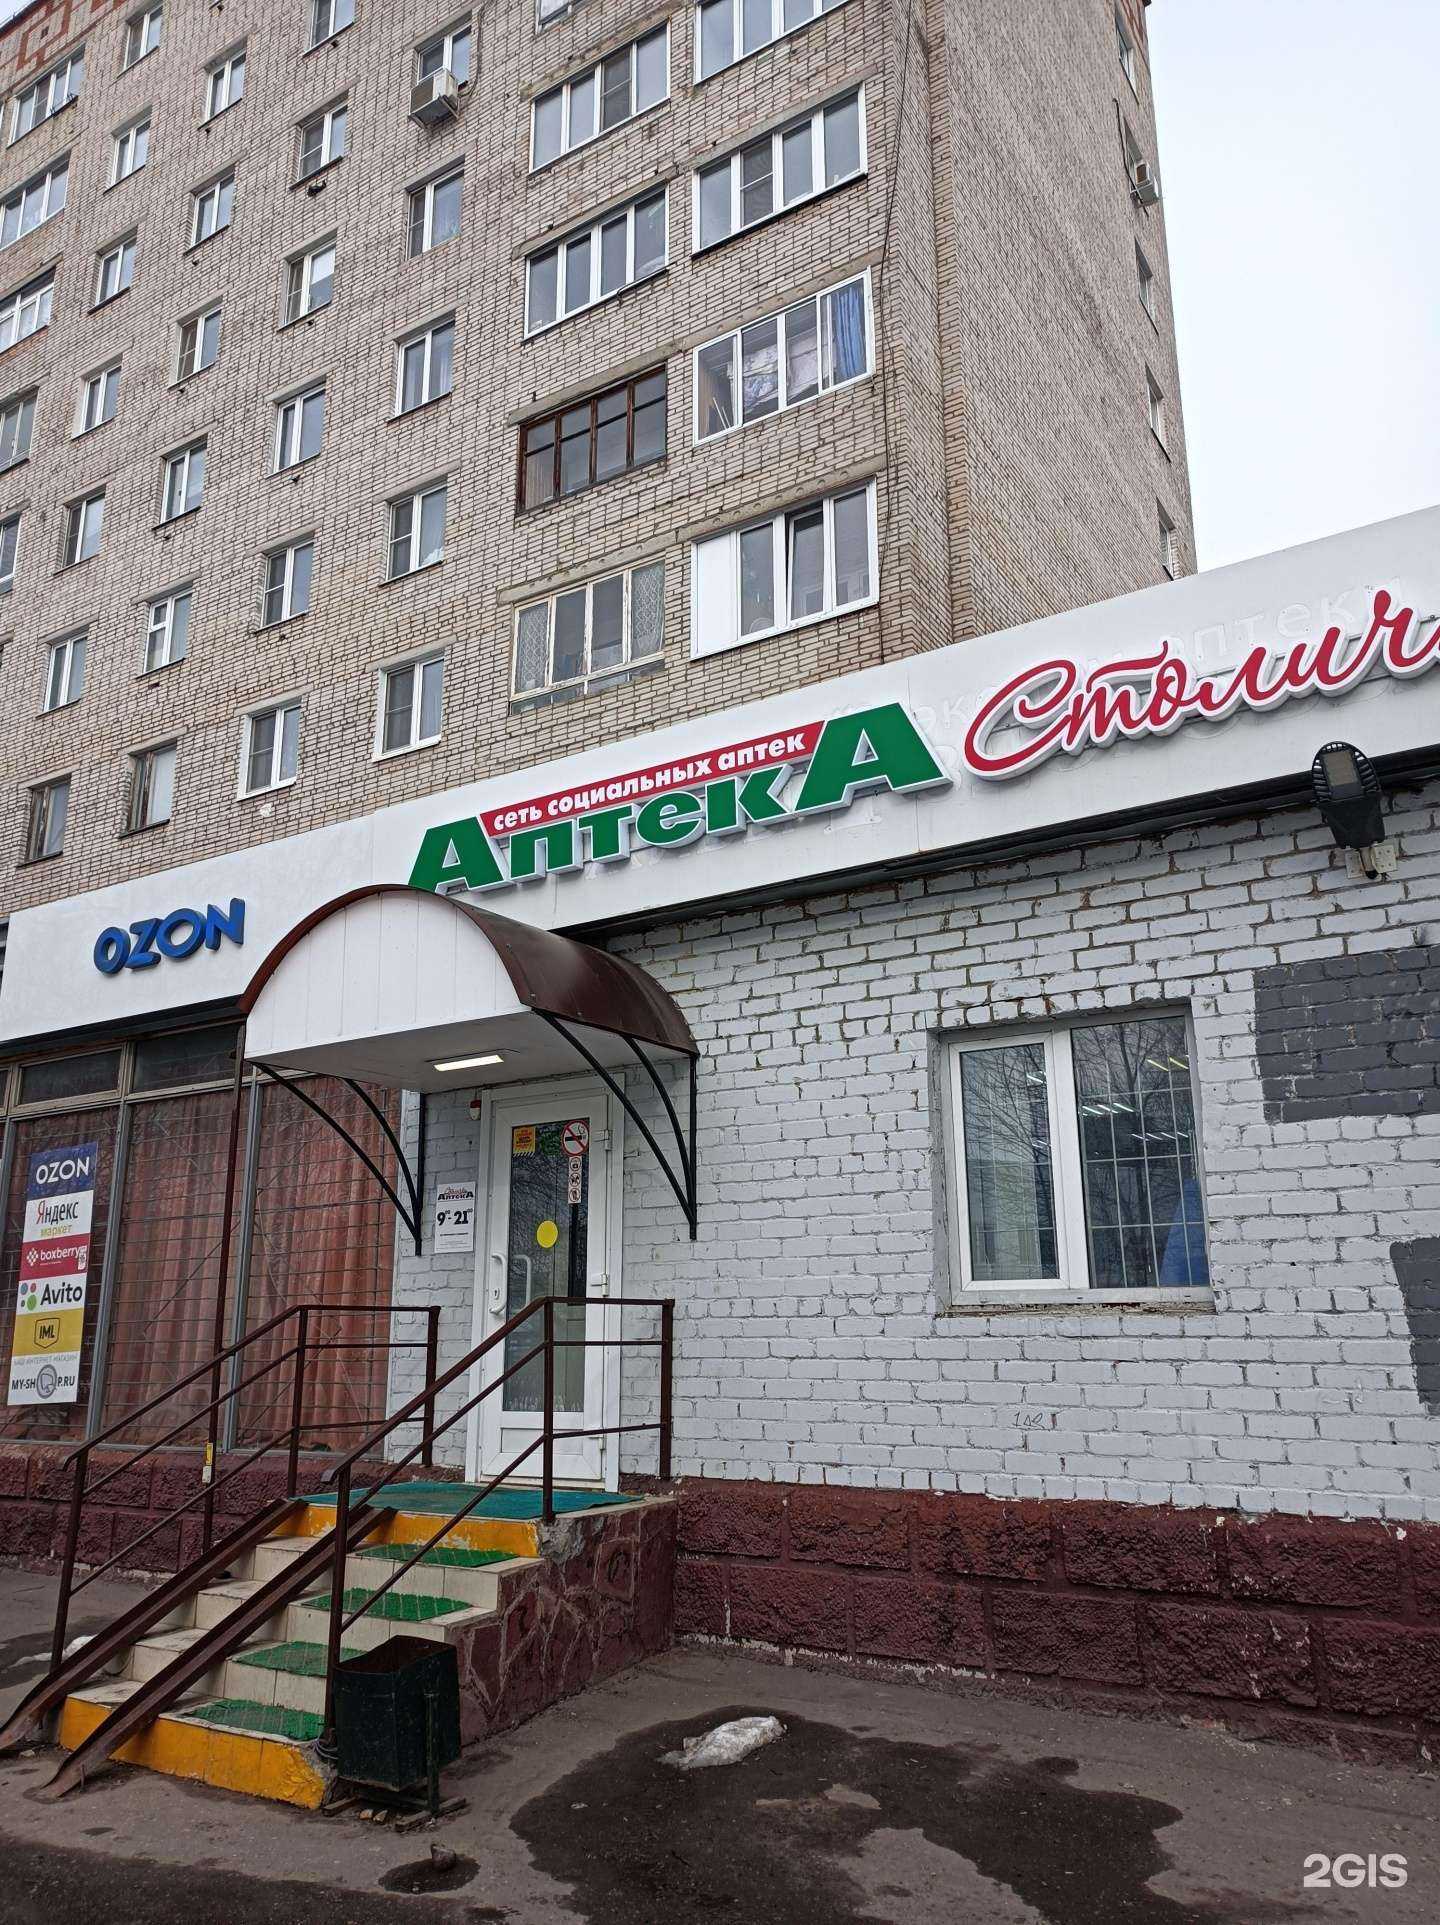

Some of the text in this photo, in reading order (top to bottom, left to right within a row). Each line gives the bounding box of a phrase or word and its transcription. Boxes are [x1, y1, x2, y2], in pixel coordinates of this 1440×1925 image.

[962, 587, 1440, 776] Столич
[493, 732, 806, 831] сеть социальных аптек
[94, 898, 245, 975] OZON
[36, 1157, 90, 1184] OZON
[36, 1200, 79, 1225] Яндекс
[41, 1225, 72, 1237] маркет
[40, 1247, 80, 1260] boxberry
[41, 1284, 83, 1306] Avito
[39, 1324, 55, 1340] IML
